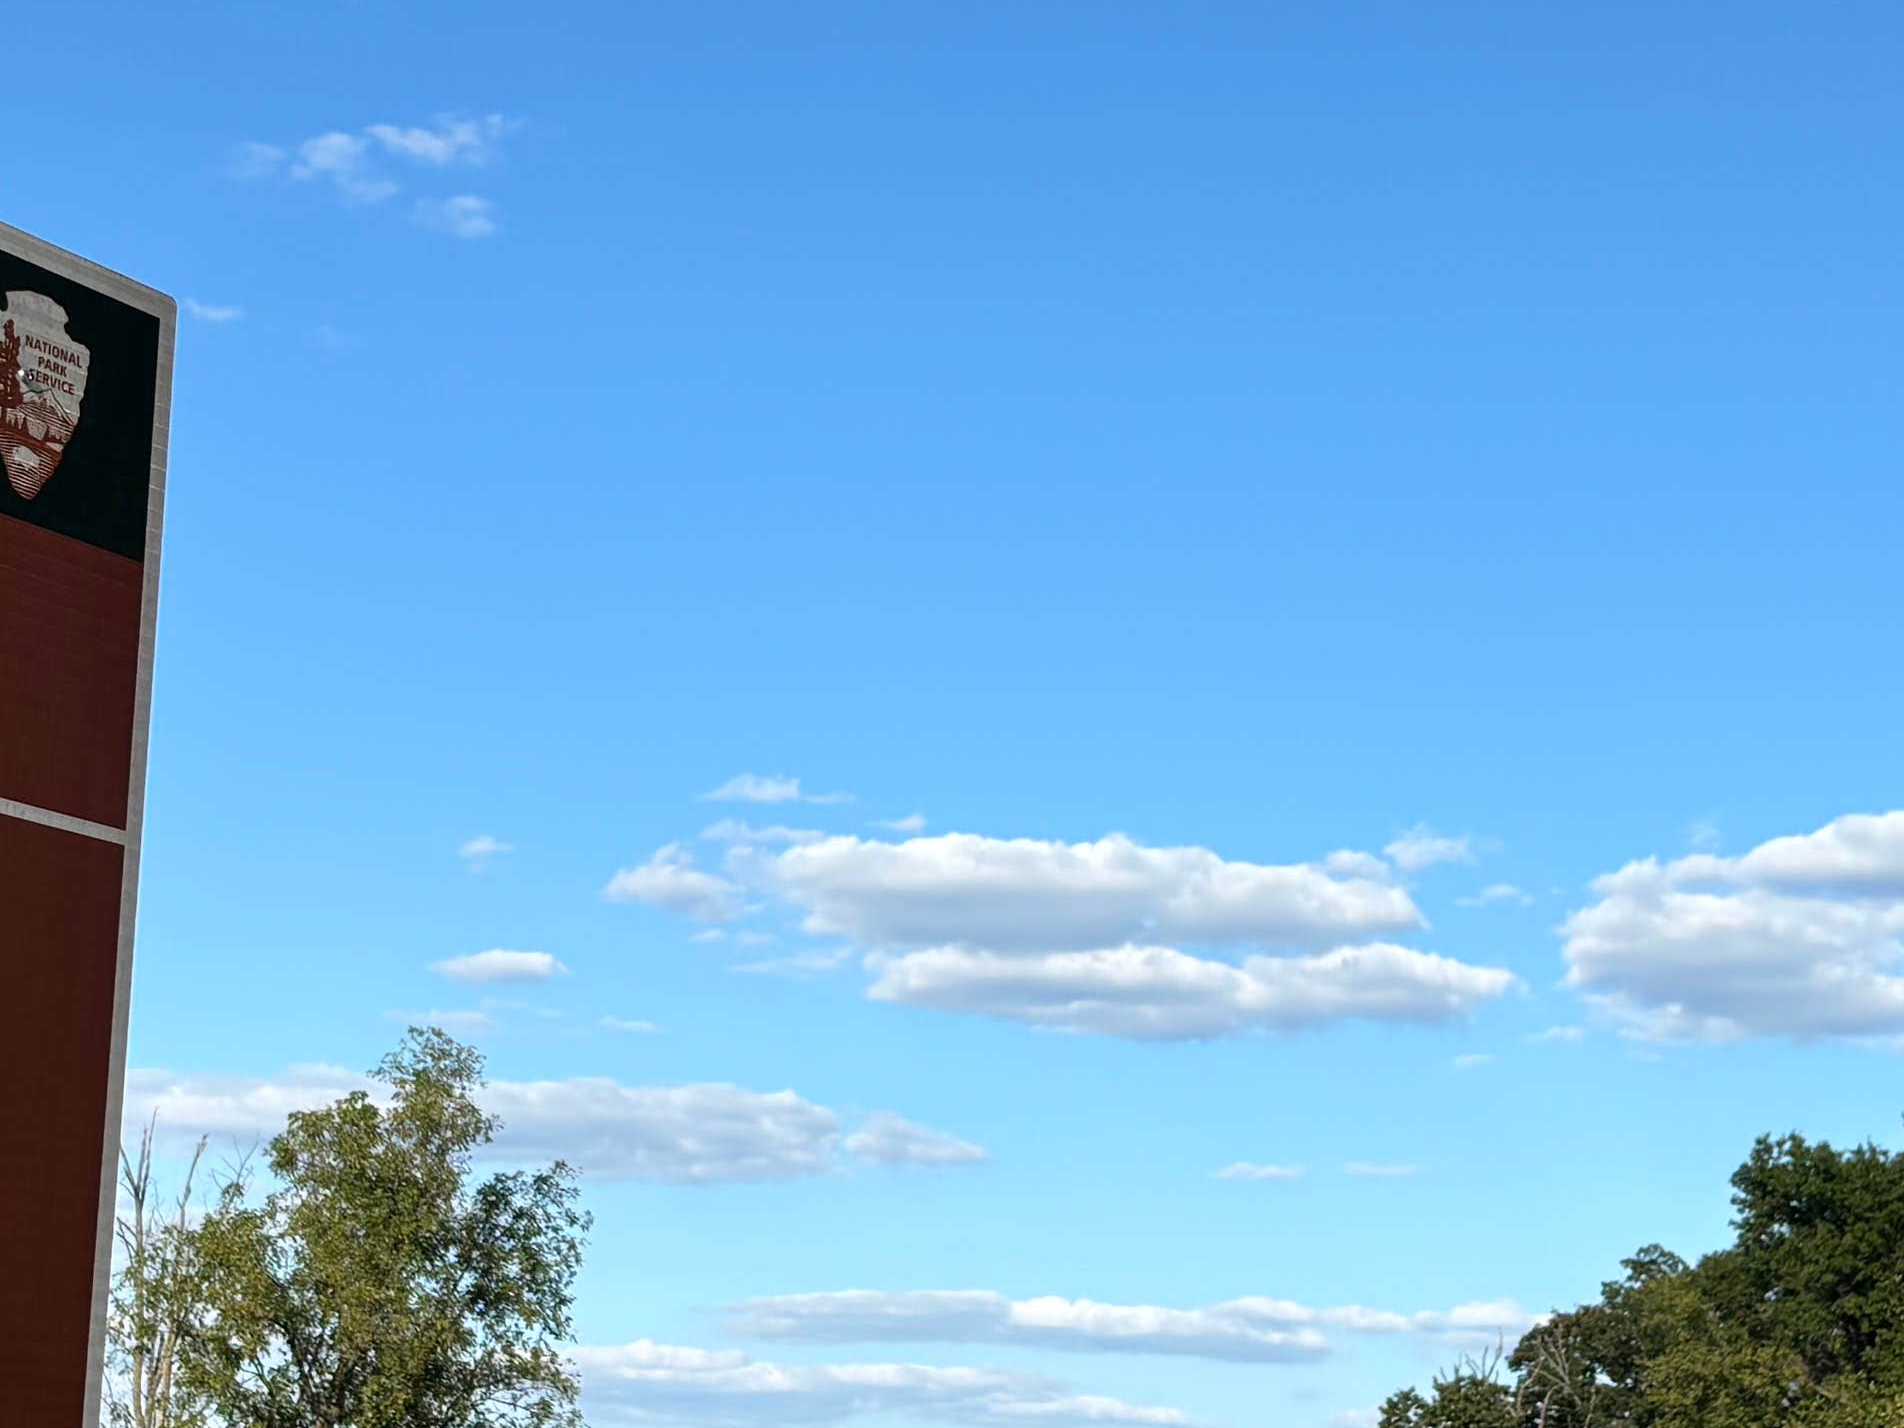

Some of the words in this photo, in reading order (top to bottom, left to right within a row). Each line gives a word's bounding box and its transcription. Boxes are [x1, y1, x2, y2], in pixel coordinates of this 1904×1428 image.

[25, 335, 83, 369] NATIONAL
[37, 356, 68, 378] PARK
[28, 369, 75, 395] SERVICE
